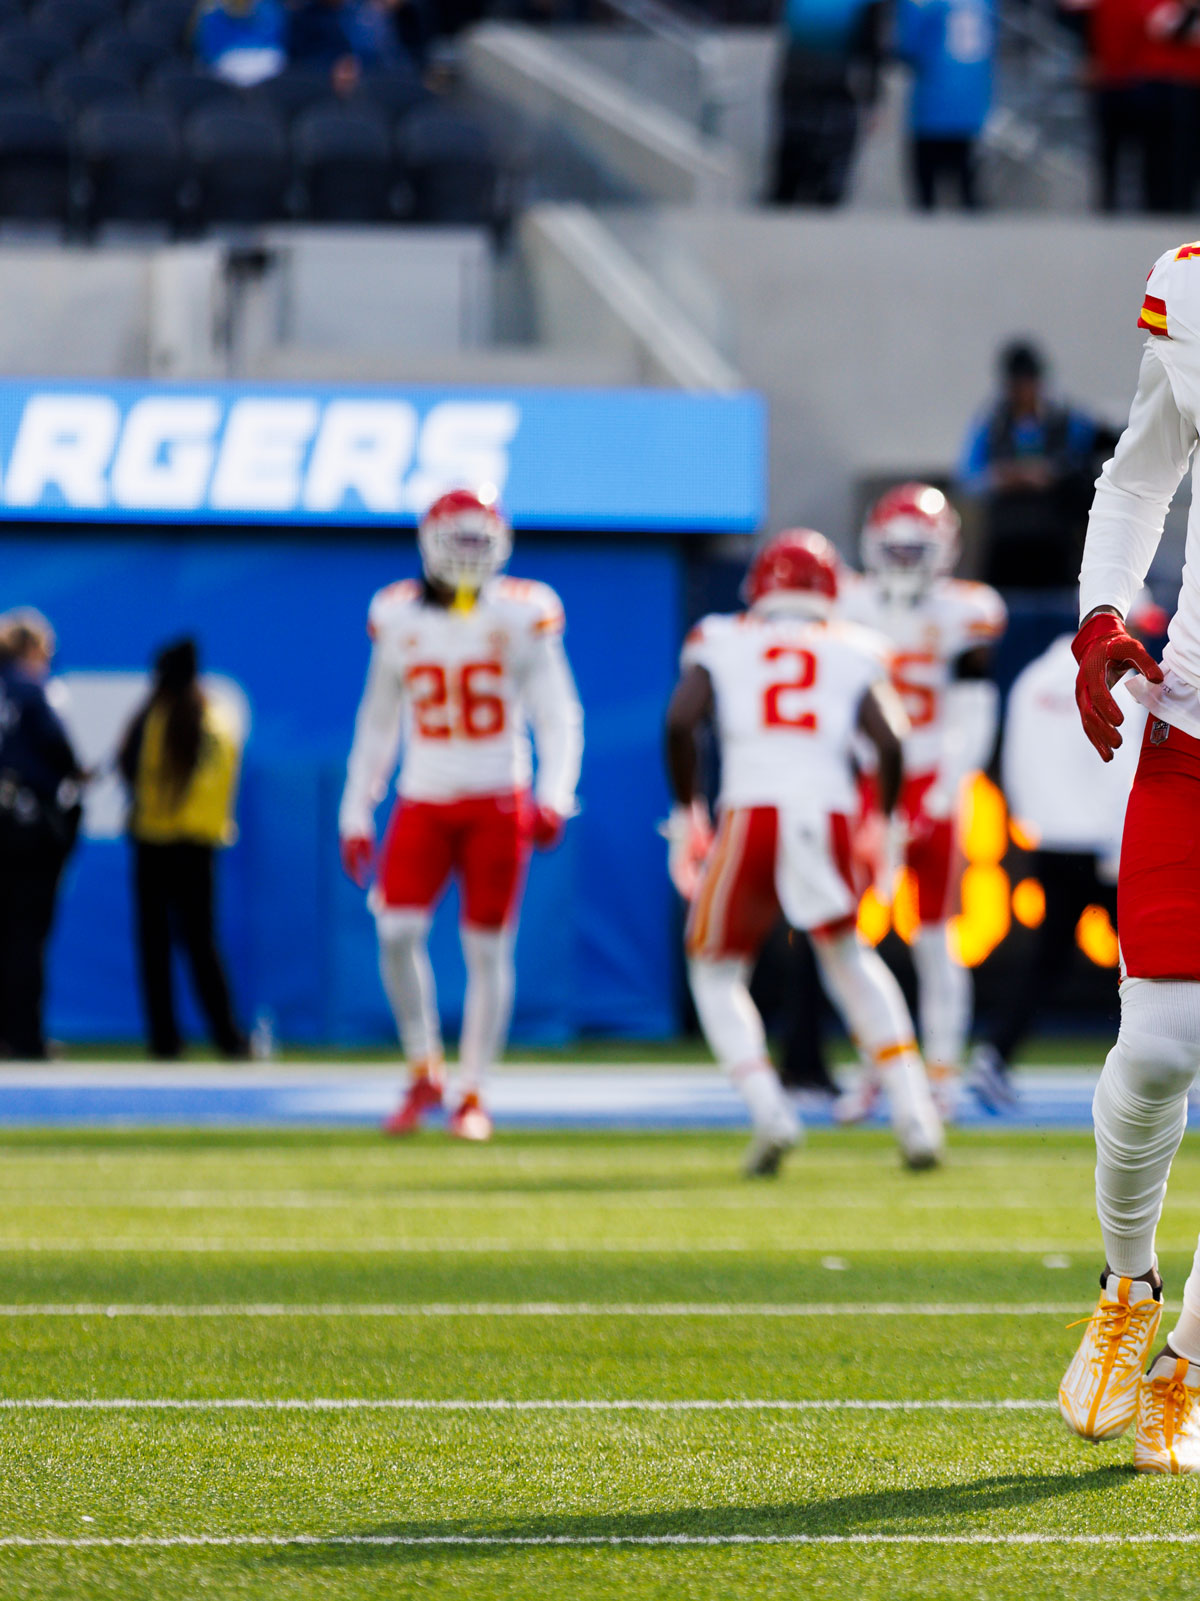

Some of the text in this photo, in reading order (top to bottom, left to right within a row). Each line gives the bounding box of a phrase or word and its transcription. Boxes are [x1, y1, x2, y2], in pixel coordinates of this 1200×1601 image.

[2, 396, 519, 514] RGERS
[405, 661, 507, 742] 26
[761, 644, 818, 735] 2
[888, 648, 938, 730] 5
